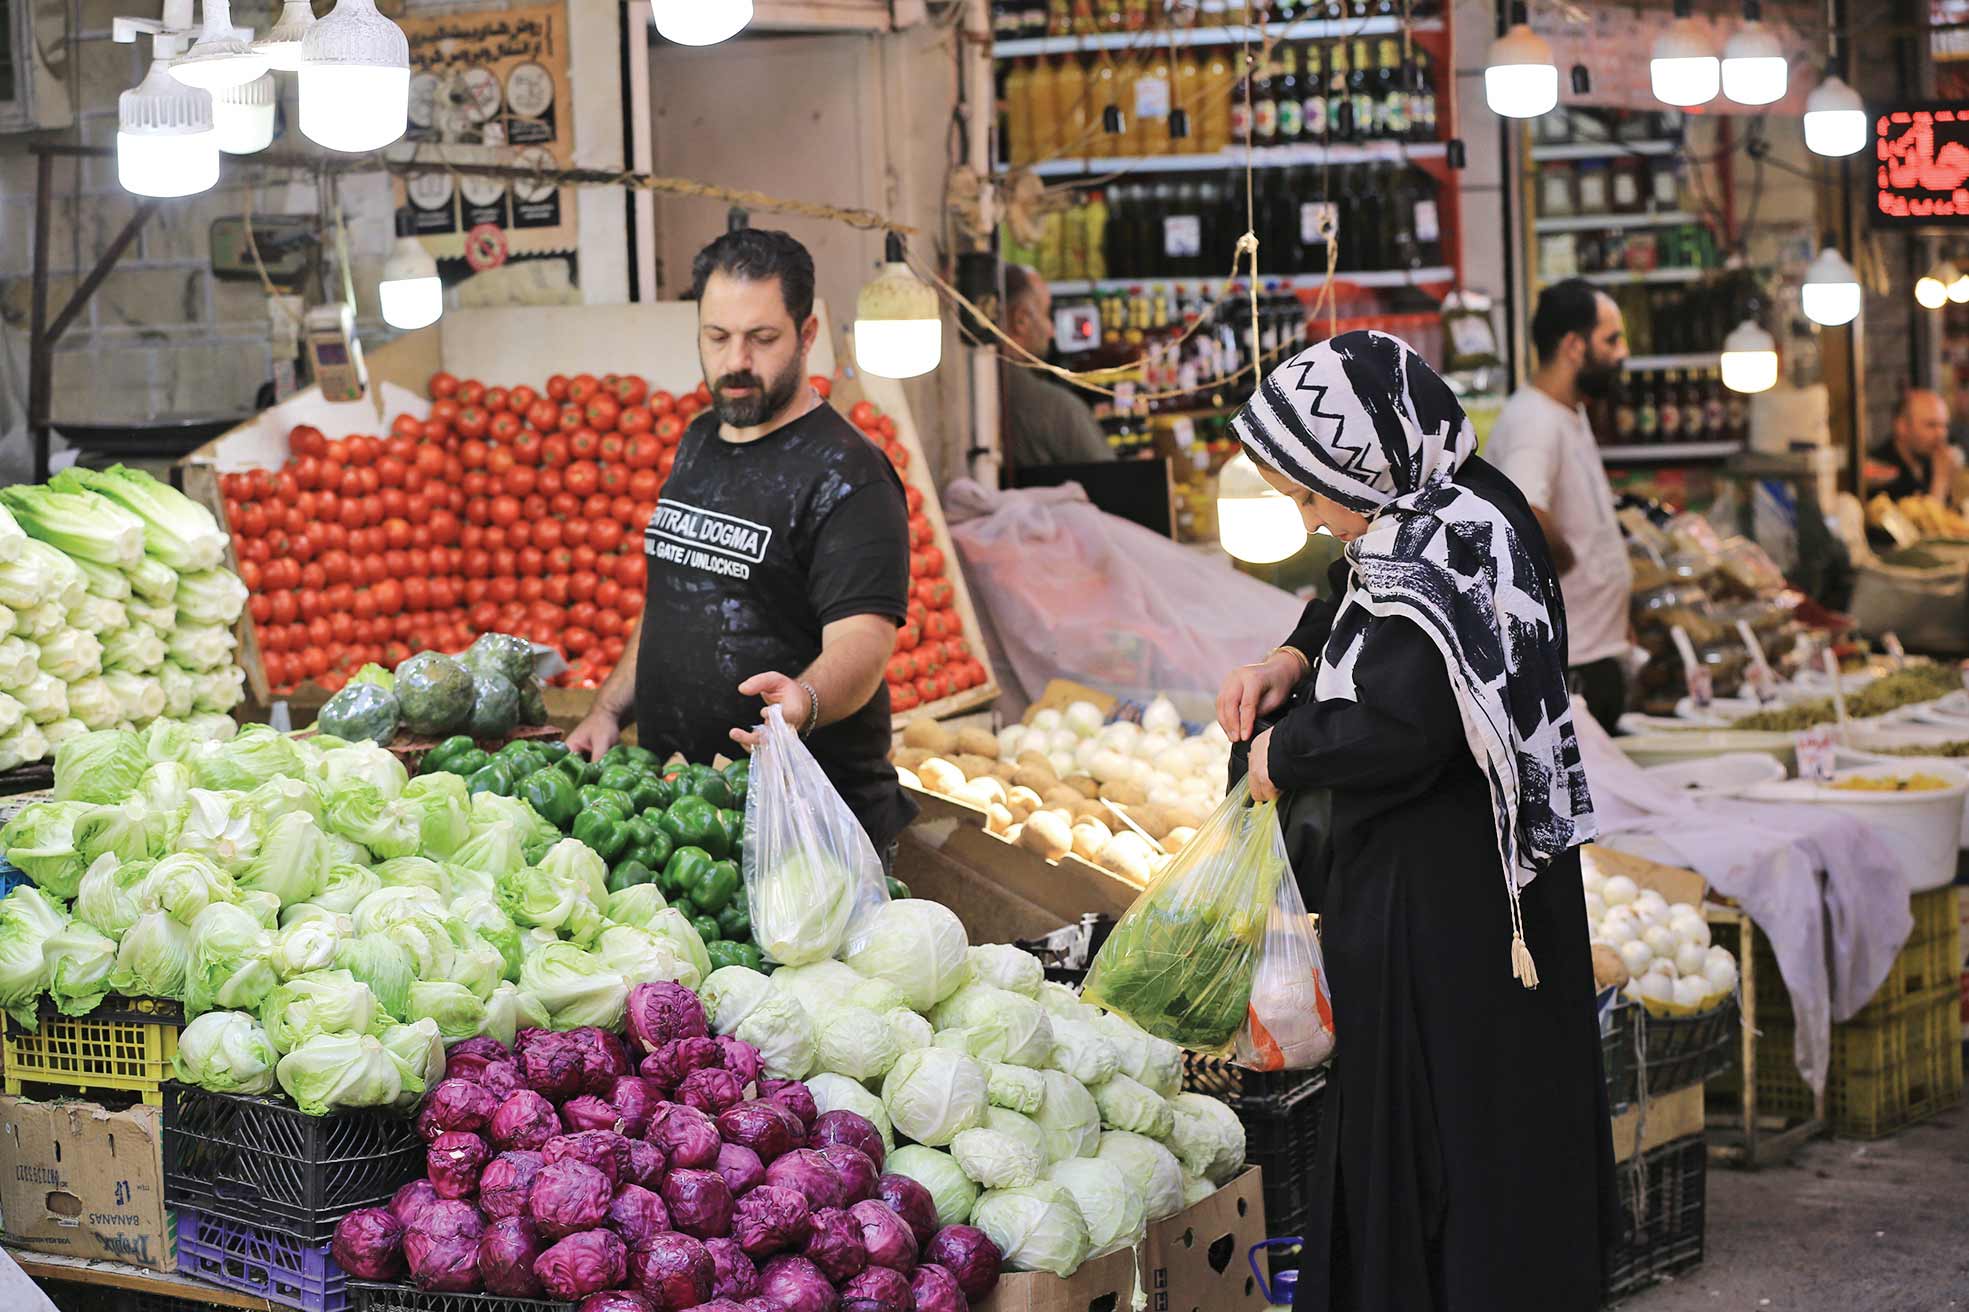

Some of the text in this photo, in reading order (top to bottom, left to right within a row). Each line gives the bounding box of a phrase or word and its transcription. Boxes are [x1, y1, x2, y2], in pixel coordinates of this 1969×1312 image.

[699, 518, 758, 554] DOGMA
[656, 541, 685, 564] GATE
[682, 549, 691, 565] /
[690, 552, 750, 580] UNLOCKED
[89, 1213, 139, 1226] BANANAS
